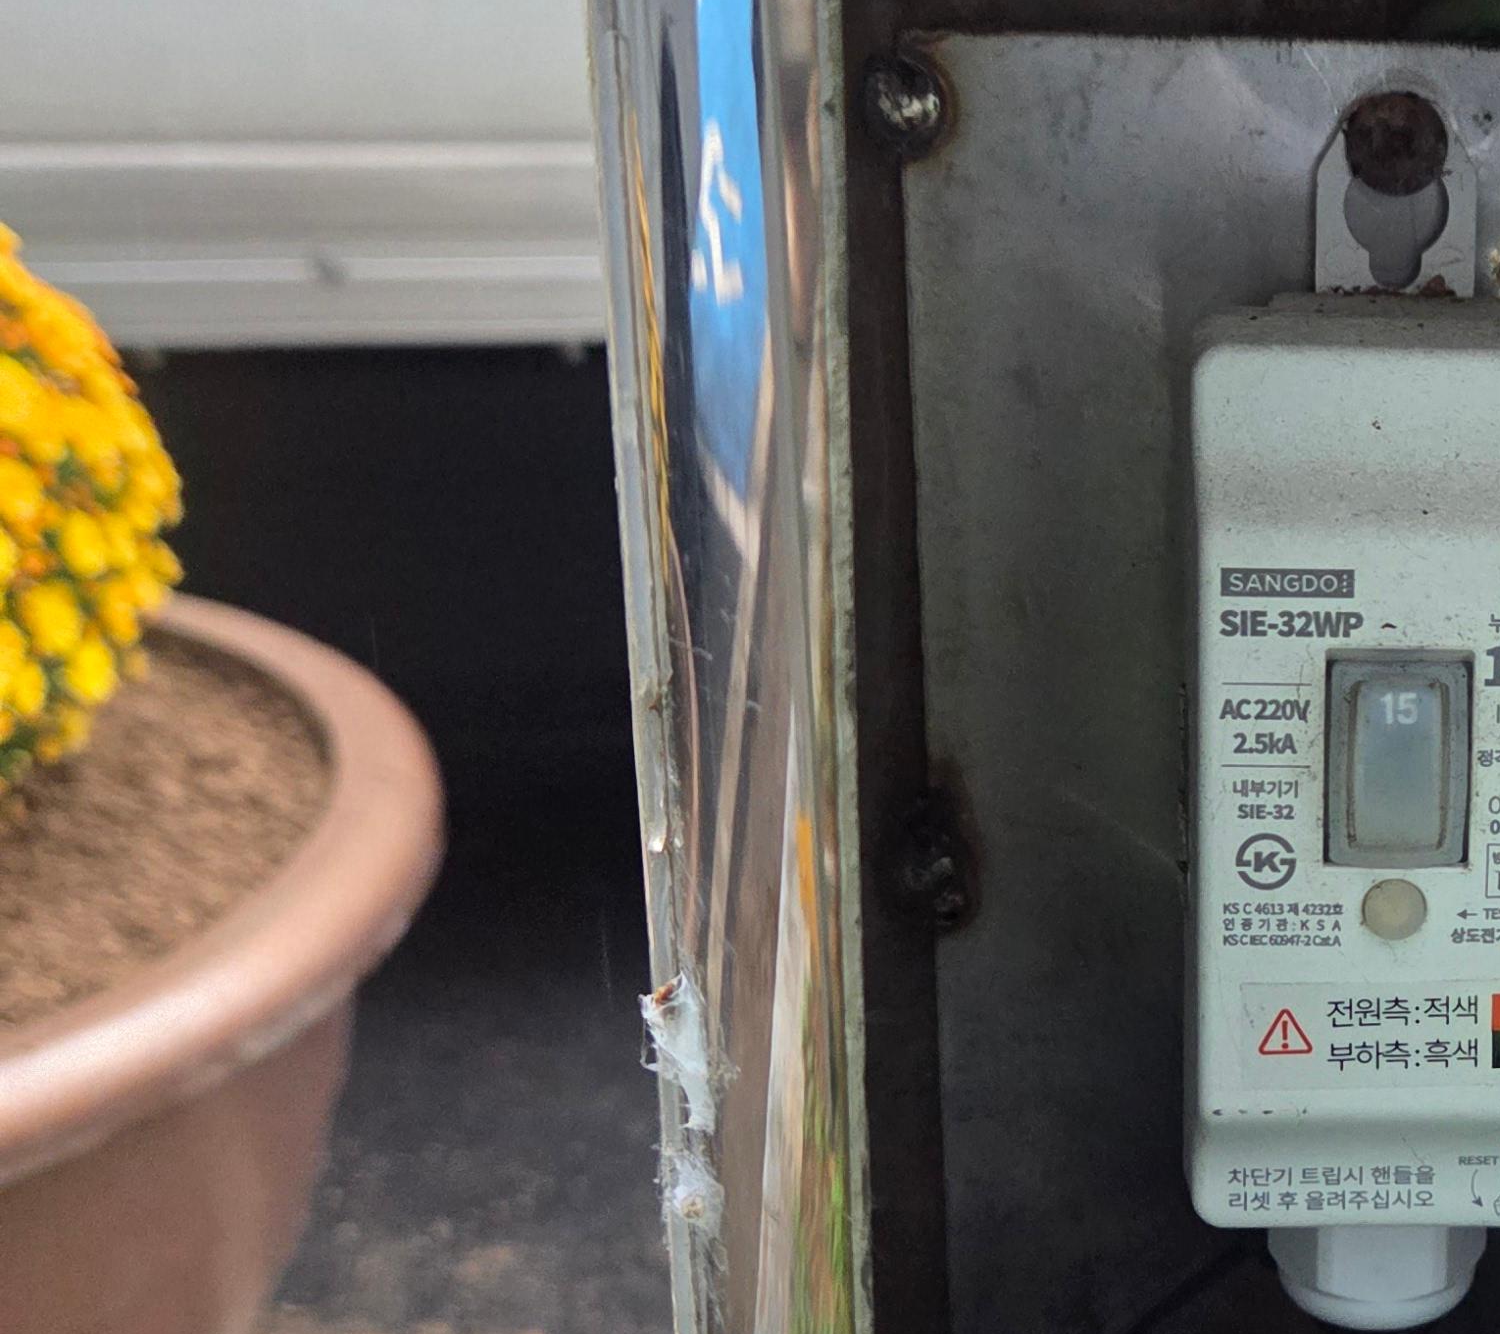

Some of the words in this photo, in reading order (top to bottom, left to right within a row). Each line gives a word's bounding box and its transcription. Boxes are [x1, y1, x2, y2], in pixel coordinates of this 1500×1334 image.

[1229, 573, 1338, 593] SANGDO
[1219, 609, 1364, 638] SIE-32WP
[1380, 691, 1418, 725] 15
[1233, 732, 1297, 753] 2.5kA
[1232, 779, 1298, 797] 내부기기
[1237, 804, 1294, 819] SIE-32
[1458, 1155, 1500, 1167] RESET
[1228, 1166, 1293, 1188] 차단기
[1299, 1166, 1364, 1186] 트립시
[1228, 1190, 1271, 1212] 리셋
[1277, 1189, 1299, 1212] 후
[1304, 1189, 1436, 1212] 올려주십시오
